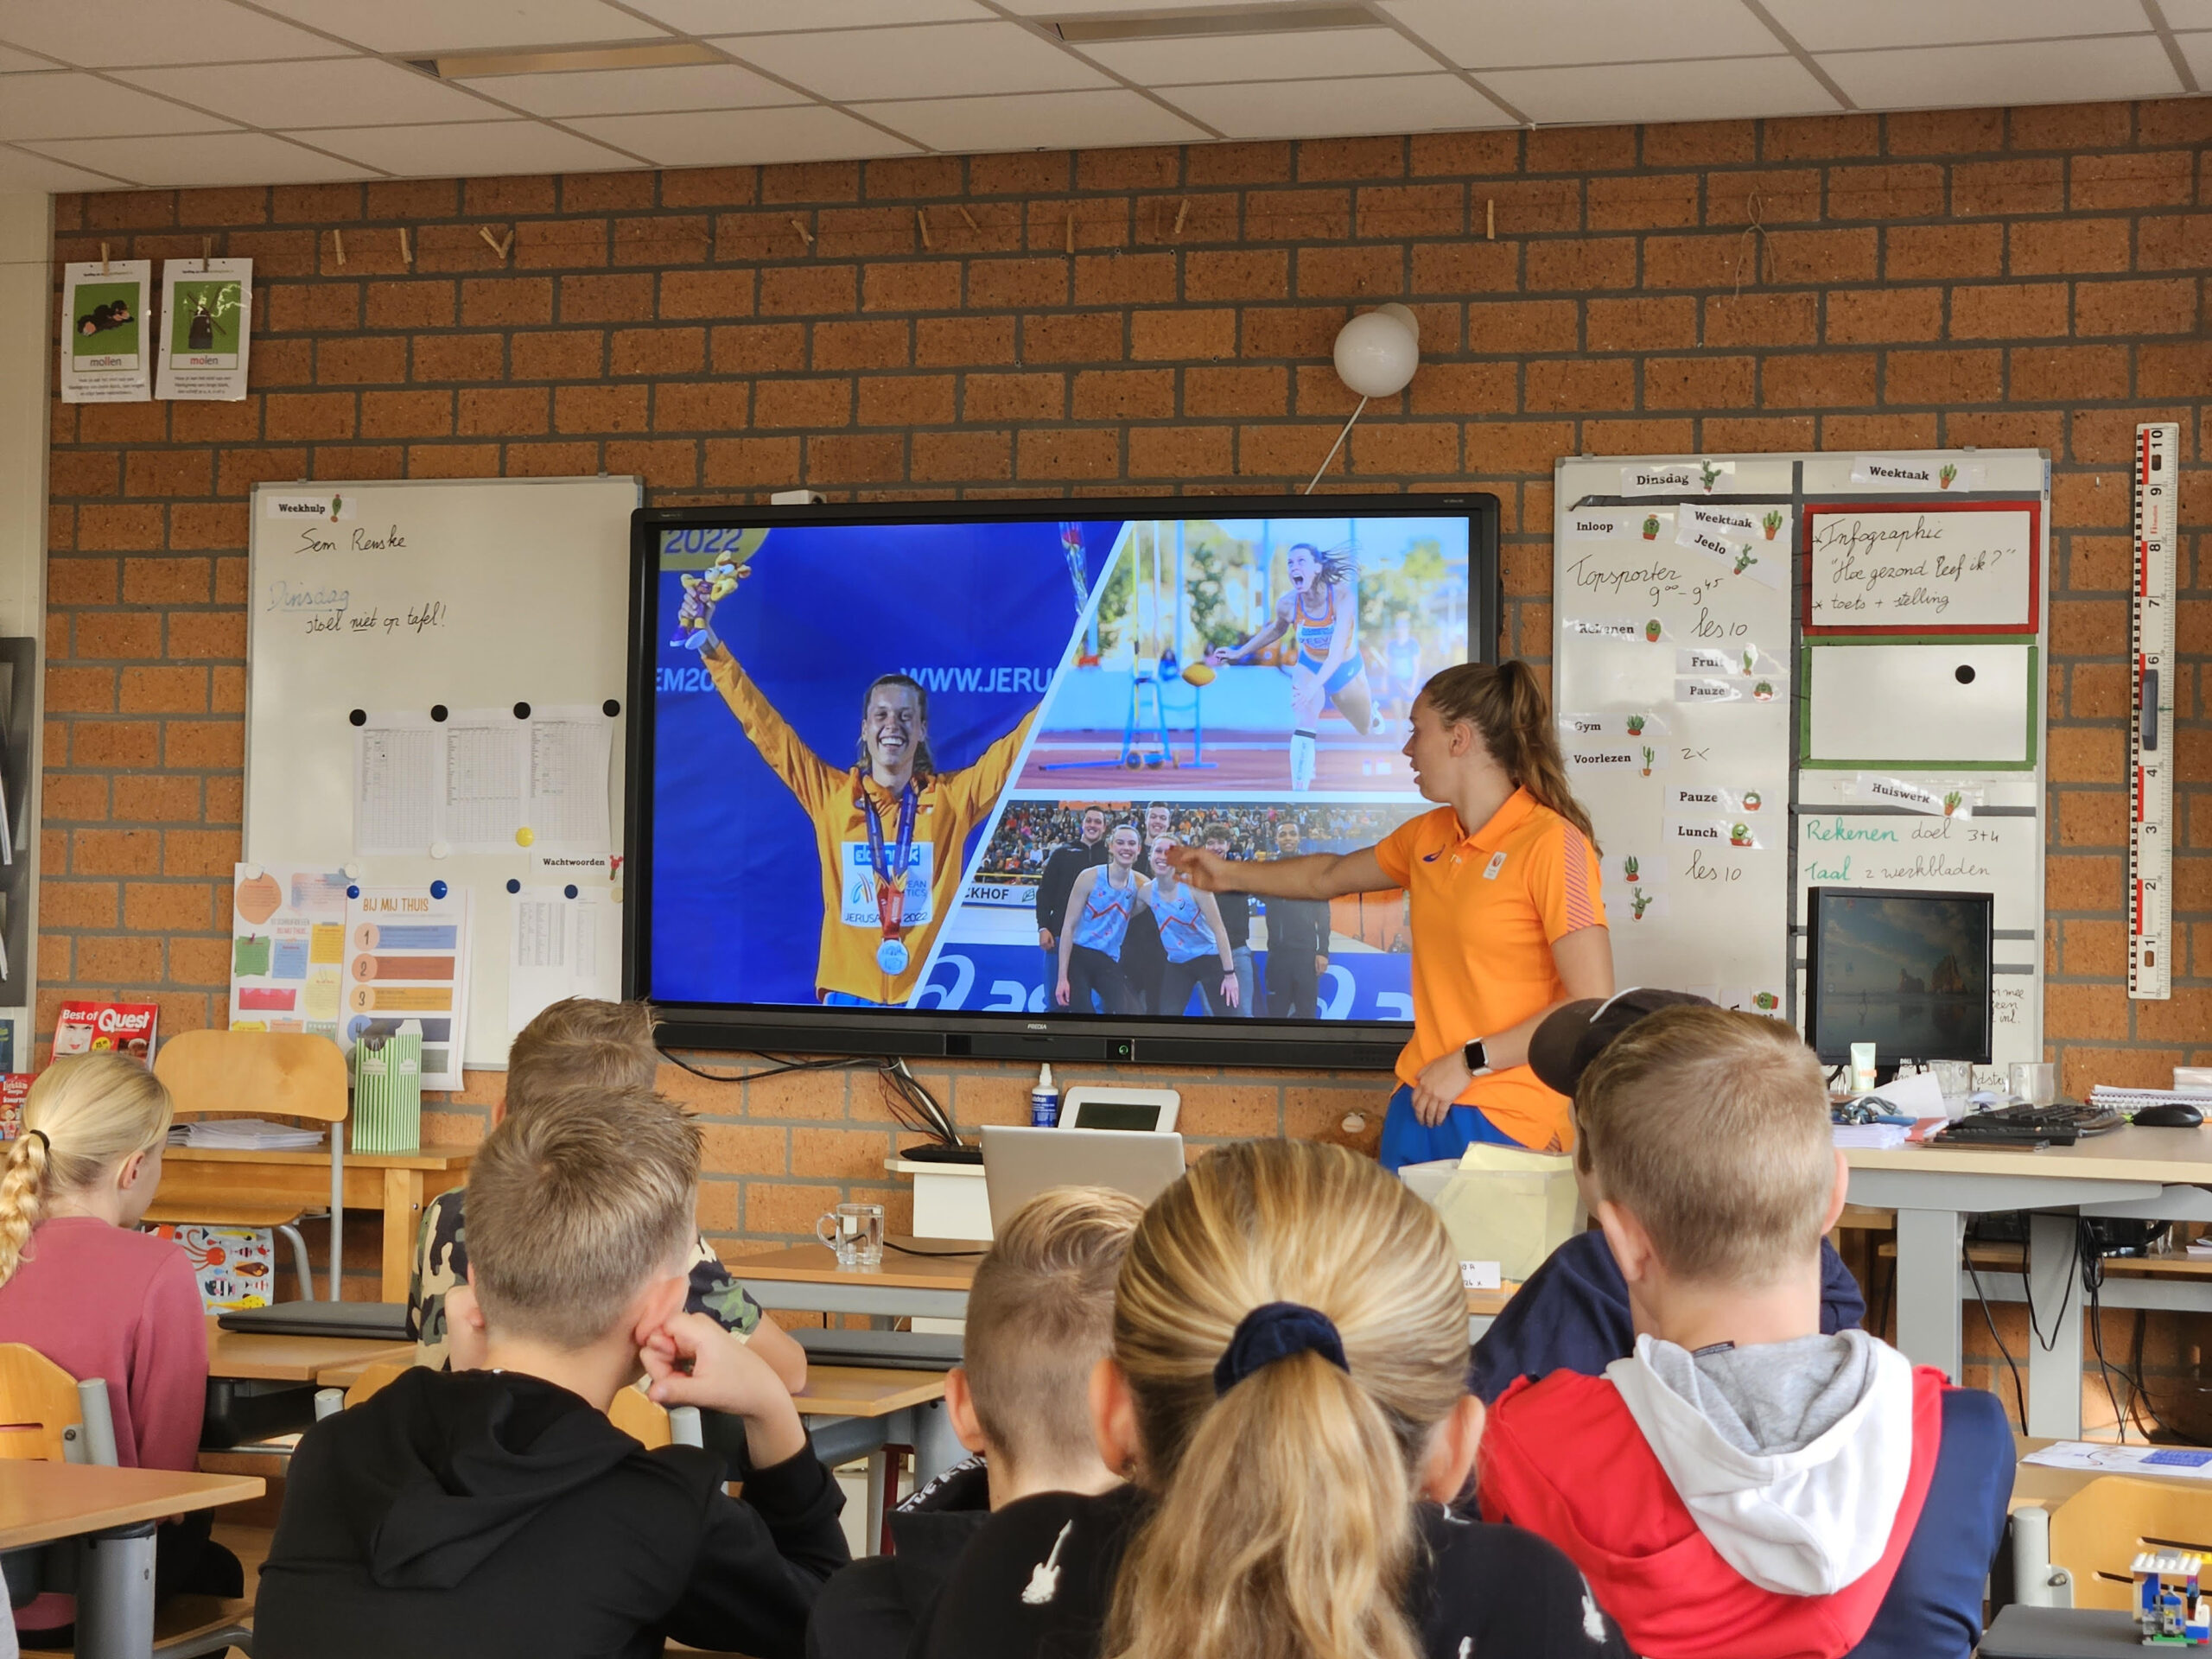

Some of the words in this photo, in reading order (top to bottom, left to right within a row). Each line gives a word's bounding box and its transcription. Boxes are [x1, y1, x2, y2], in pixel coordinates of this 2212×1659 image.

[90, 357, 122, 366] mollen
[190, 356, 219, 365] molen
[2152, 429, 2163, 448] 10
[1868, 466, 1929, 480] Weektaak
[1636, 474, 1689, 486] Dinsdag
[2151, 487, 2162, 496] 9
[278, 503, 326, 514] Weekhulp
[1694, 511, 1752, 529] Weektaak
[1576, 522, 1614, 532] Inloop
[296, 528, 337, 554] Sem
[664, 528, 743, 554] 2022
[1818, 516, 1943, 557] Infographic
[1694, 534, 1726, 556] Jeelo
[2150, 543, 2161, 552] 8
[1869, 561, 1929, 591] gezond
[2149, 600, 2160, 608] 7
[350, 606, 377, 631] niet
[1691, 657, 1724, 667] Frui
[2148, 656, 2159, 664] 6
[1689, 686, 1726, 696] Pauze
[1574, 721, 1602, 733] Gym
[1573, 753, 1632, 764] Voorlezen
[1679, 791, 1719, 803] Pauze
[1872, 782, 1930, 804] Huiswerk
[1678, 826, 1719, 838] Lunch
[1806, 817, 1899, 842] Rekenen
[1910, 817, 1951, 840] doel
[2145, 825, 2158, 834] 3
[543, 857, 606, 867] Wachtwoorden
[1805, 856, 1851, 881] Taal
[2145, 881, 2157, 890] 2
[363, 898, 378, 912] BIJ
[380, 898, 398, 912] MIJ
[401, 898, 429, 912] THUIS
[845, 913, 880, 924] JERUSA
[904, 912, 928, 923] 2022
[364, 930, 370, 945] 1
[359, 961, 367, 976] 2
[359, 991, 365, 1006] 3
[62, 1009, 86, 1020] Best
[86, 1011, 99, 1020] of
[98, 1008, 149, 1032] Quest
